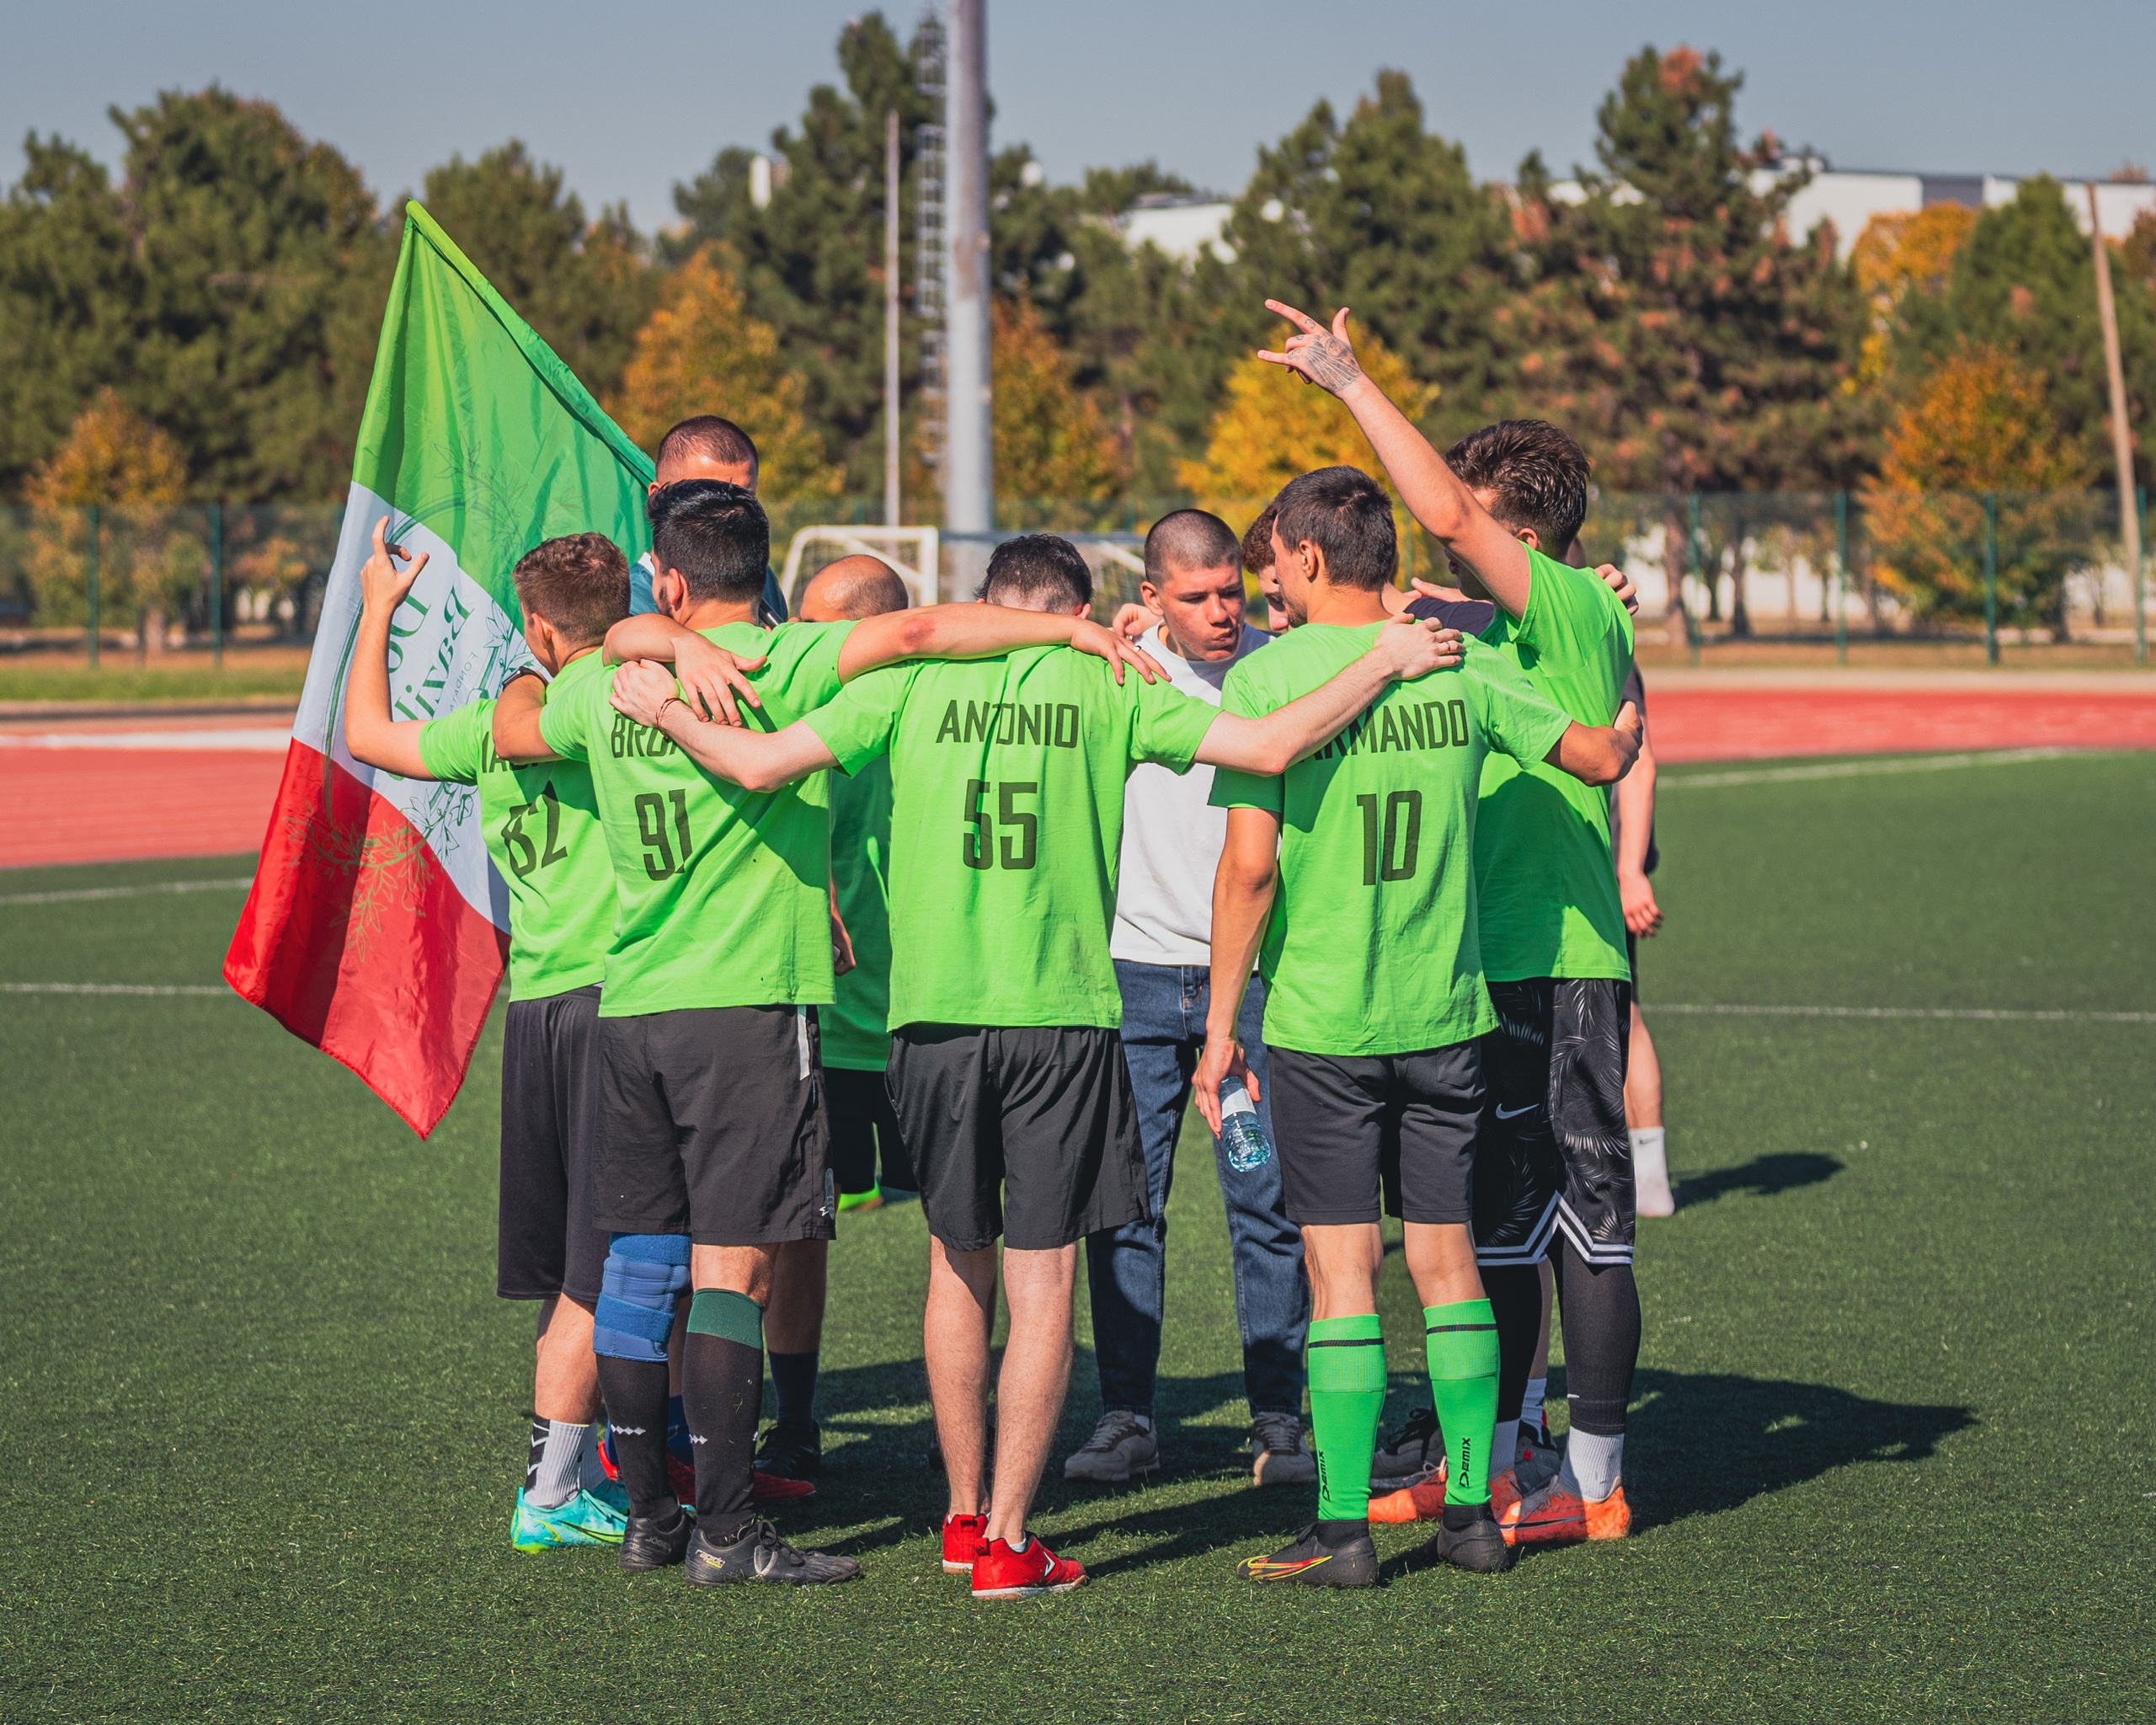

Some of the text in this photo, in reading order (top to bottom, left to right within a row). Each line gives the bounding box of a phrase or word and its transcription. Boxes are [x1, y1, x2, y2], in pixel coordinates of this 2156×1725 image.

[635, 789, 692, 880] 91
[963, 779, 1038, 870] 55
[1357, 790, 1422, 886] 10
